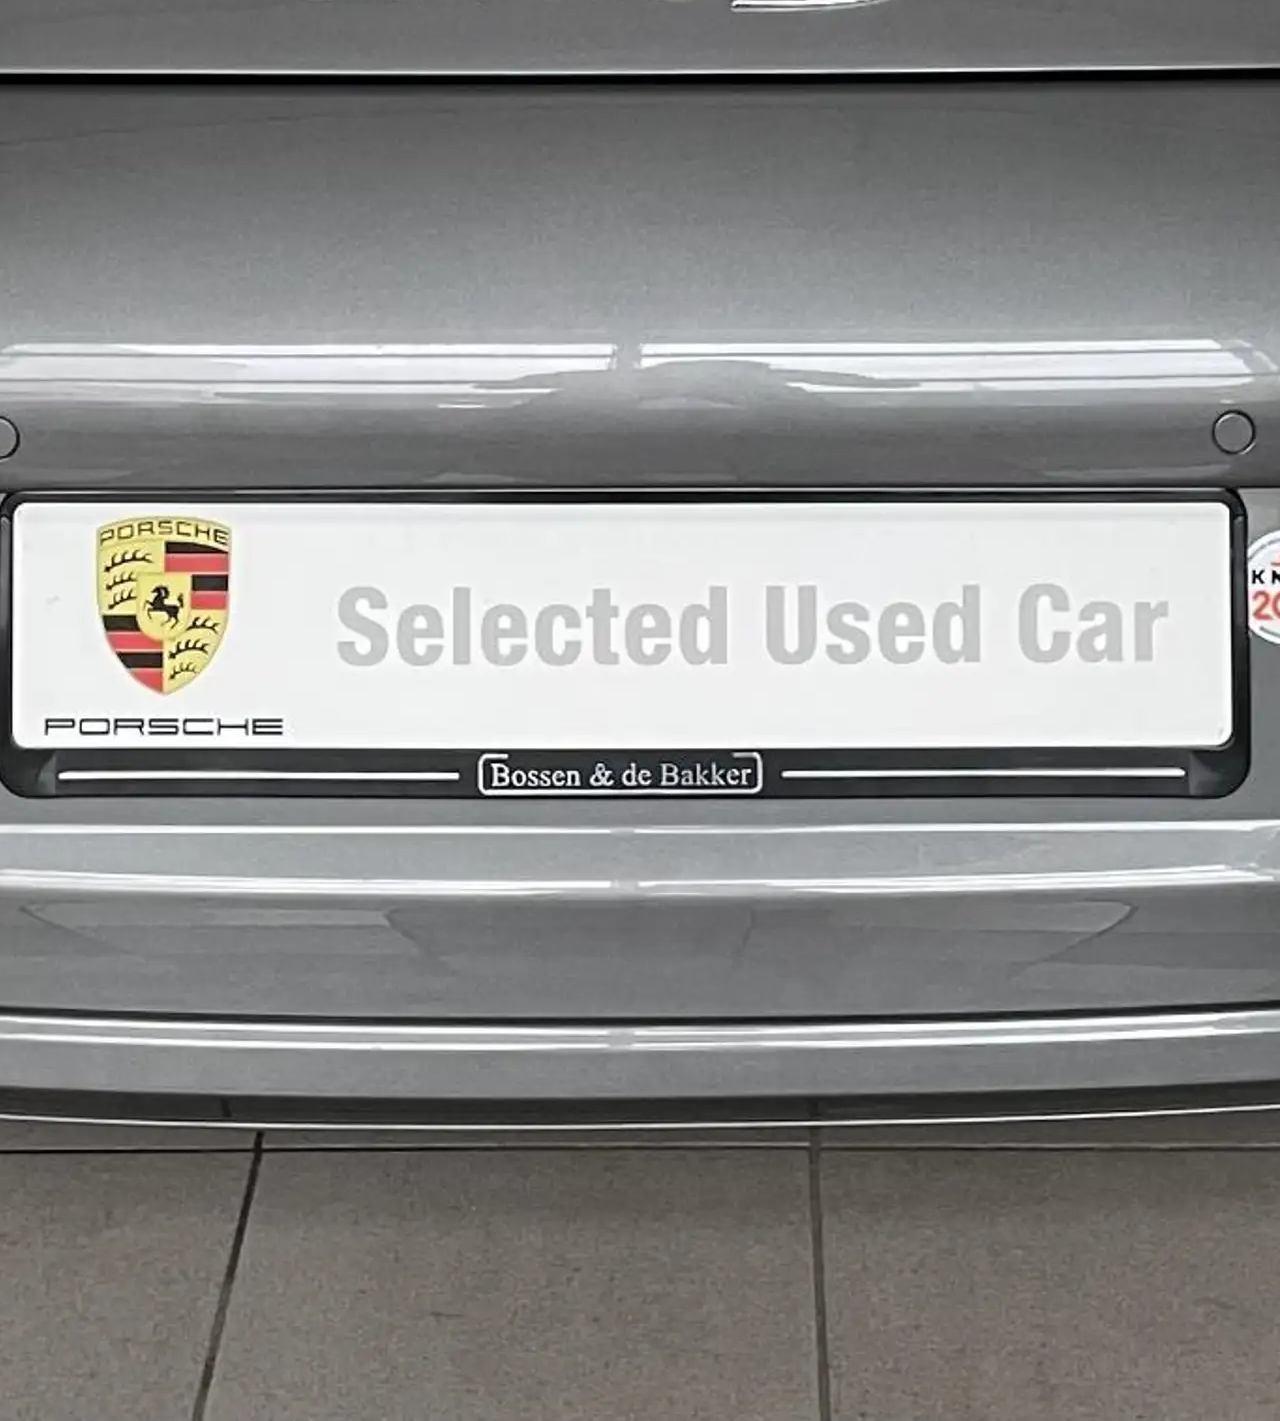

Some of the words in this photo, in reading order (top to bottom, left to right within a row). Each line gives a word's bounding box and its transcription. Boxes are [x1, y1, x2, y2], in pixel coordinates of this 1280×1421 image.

[99, 520, 229, 546] PORSCHE
[335, 585, 729, 667] Selected
[764, 583, 981, 666] Used
[1017, 582, 1169, 665] Car
[44, 717, 284, 736] PORSCHE
[489, 762, 582, 787] Bossen
[588, 762, 615, 787] &
[621, 762, 653, 787] de
[660, 761, 753, 787] Bakker
